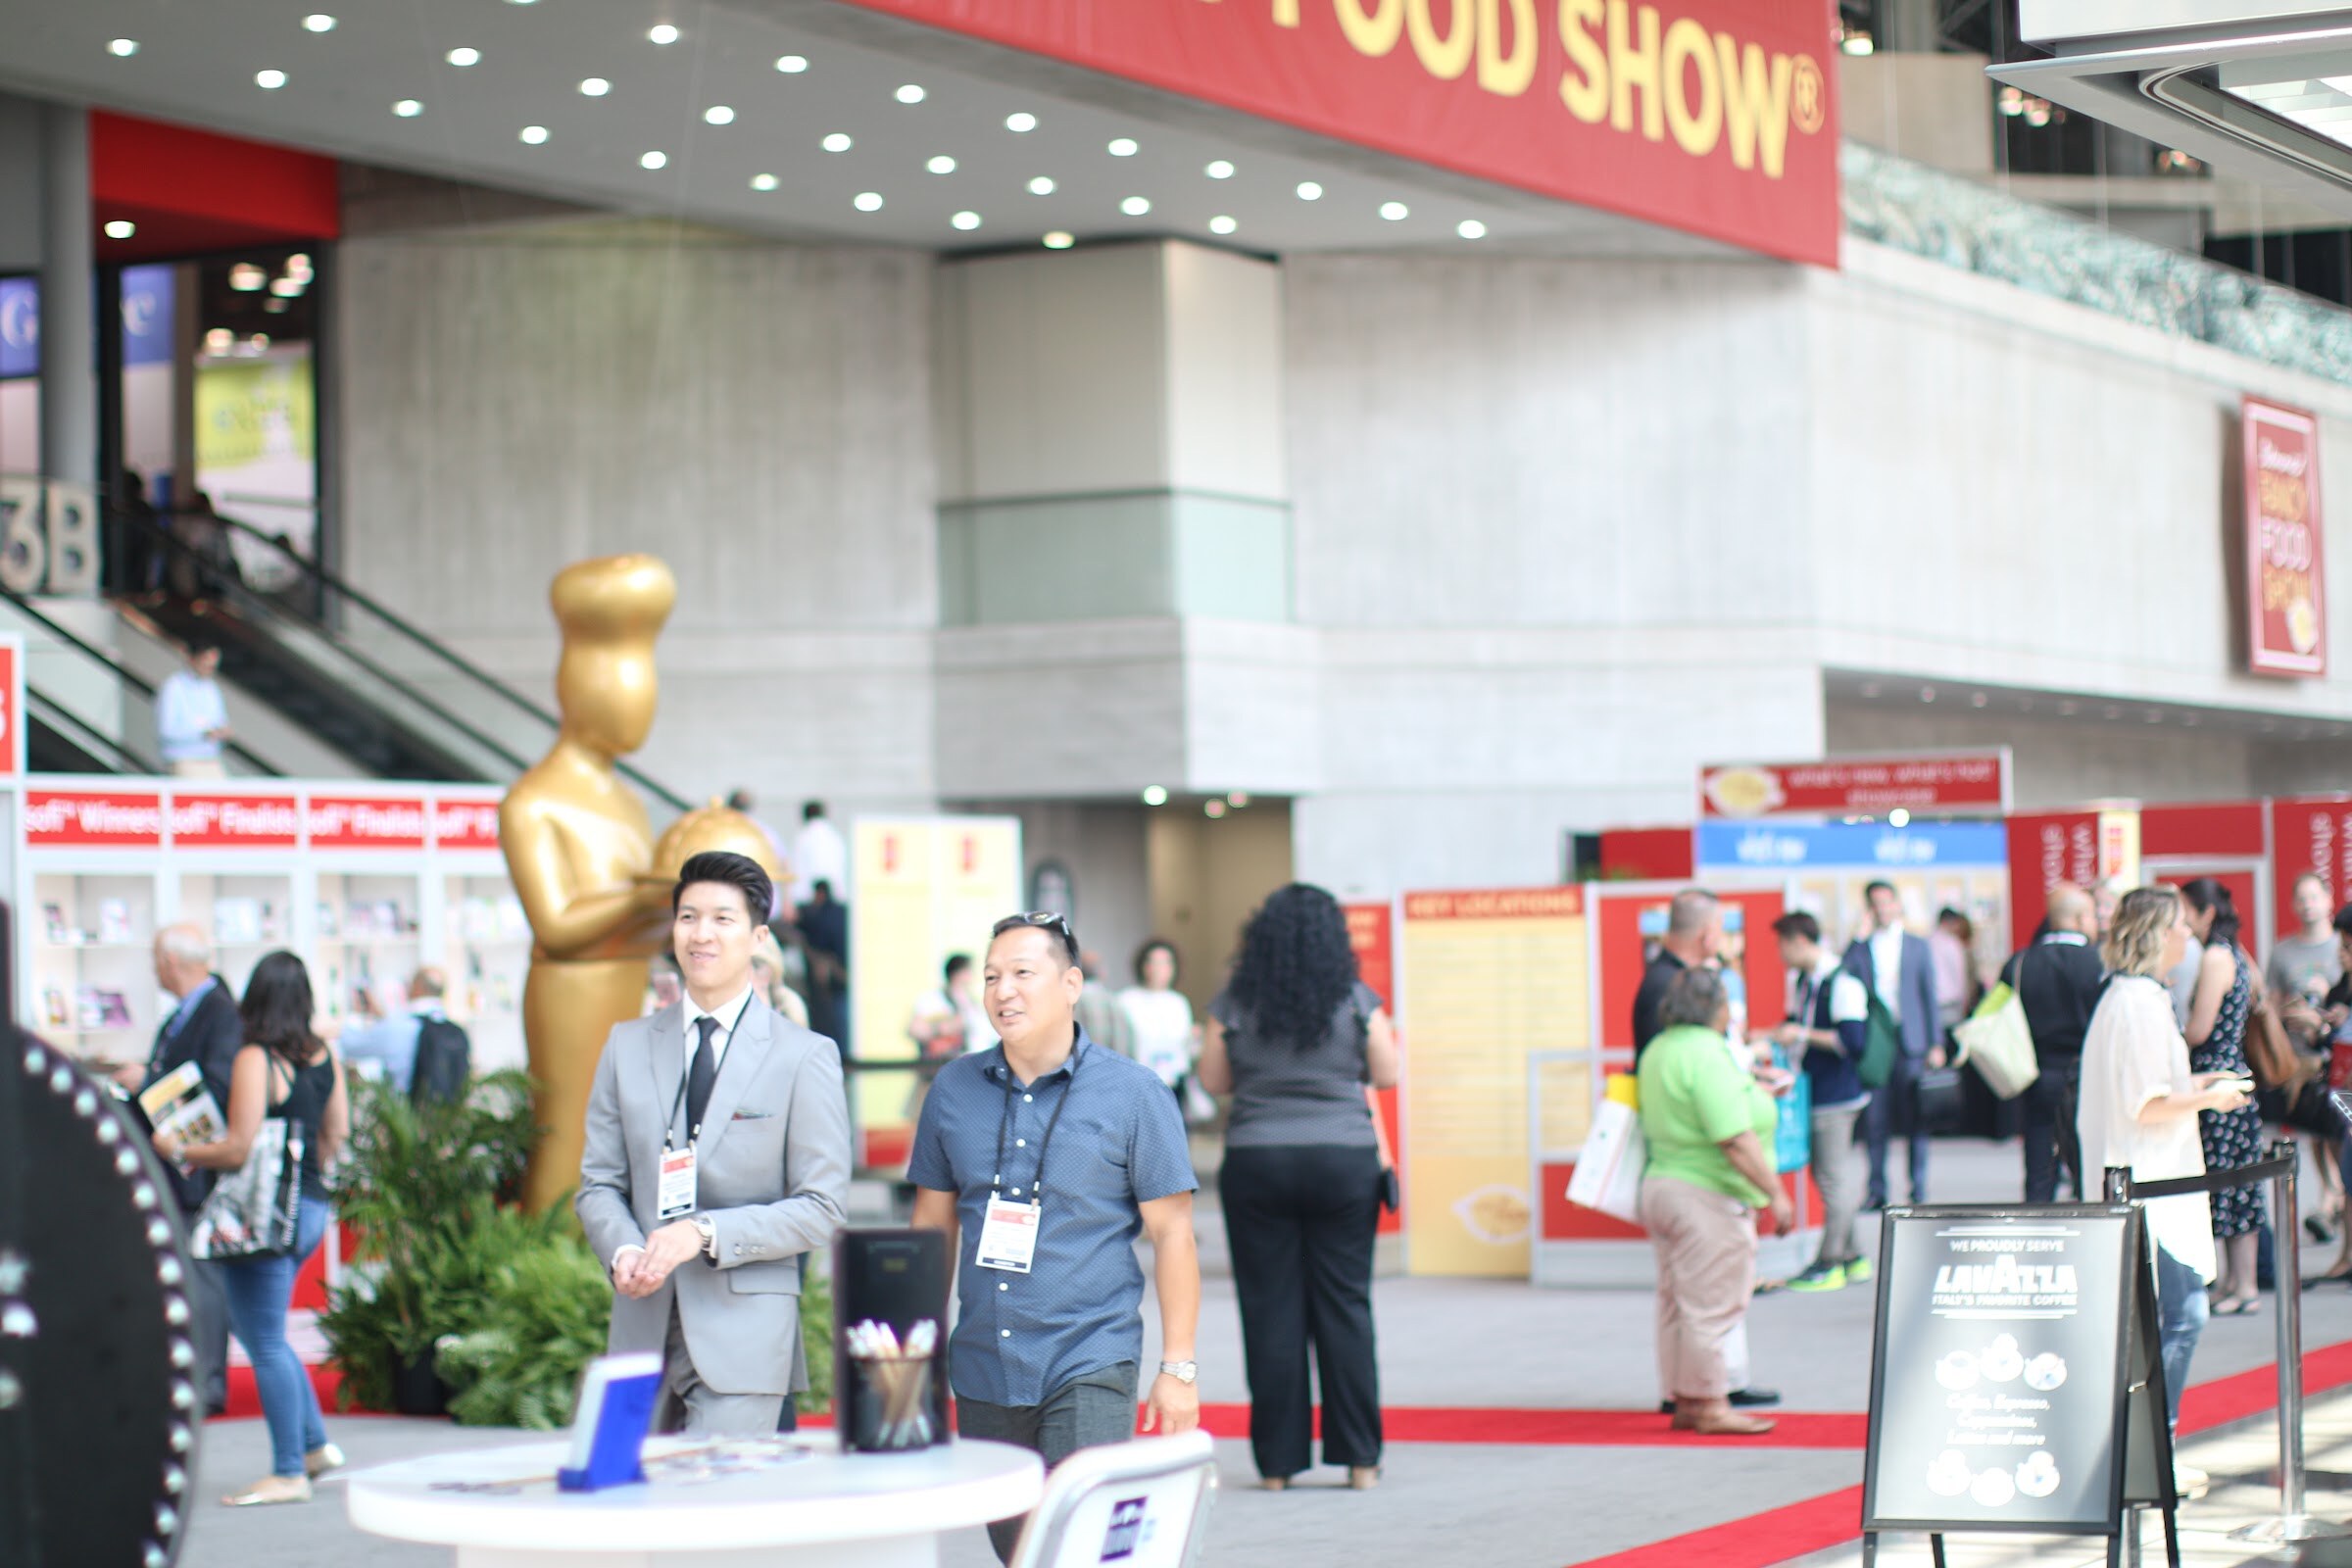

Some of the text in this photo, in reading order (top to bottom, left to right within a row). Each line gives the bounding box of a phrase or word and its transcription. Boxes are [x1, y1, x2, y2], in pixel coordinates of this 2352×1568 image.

[1950, 1240, 2065, 1252] WE PROUDLY SERVE
